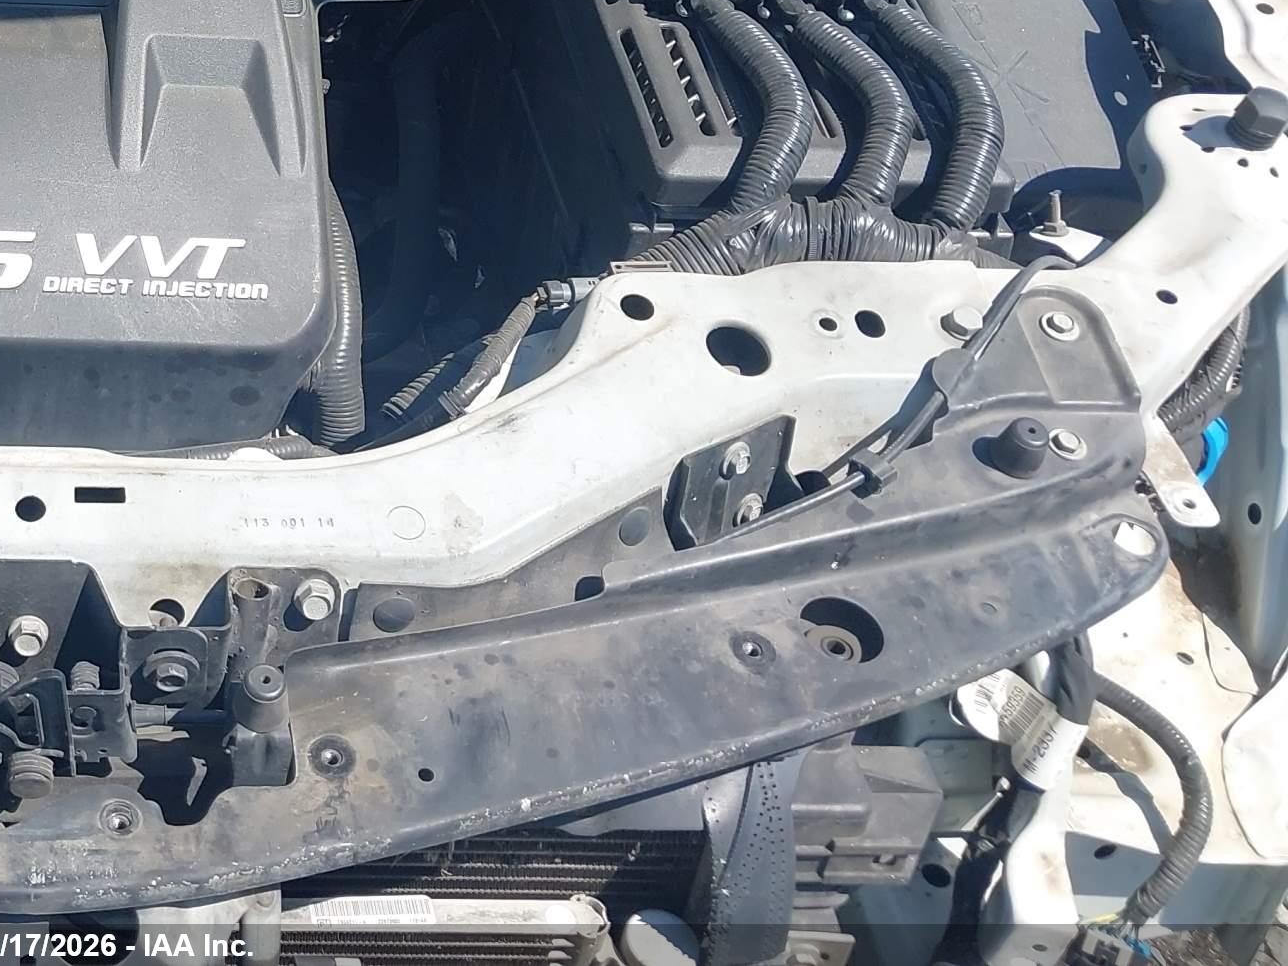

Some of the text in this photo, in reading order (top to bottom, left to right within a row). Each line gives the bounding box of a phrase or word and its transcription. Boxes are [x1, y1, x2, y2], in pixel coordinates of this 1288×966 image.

[76, 233, 246, 279] VVT
[43, 277, 269, 300] DIRECT INJECTION
